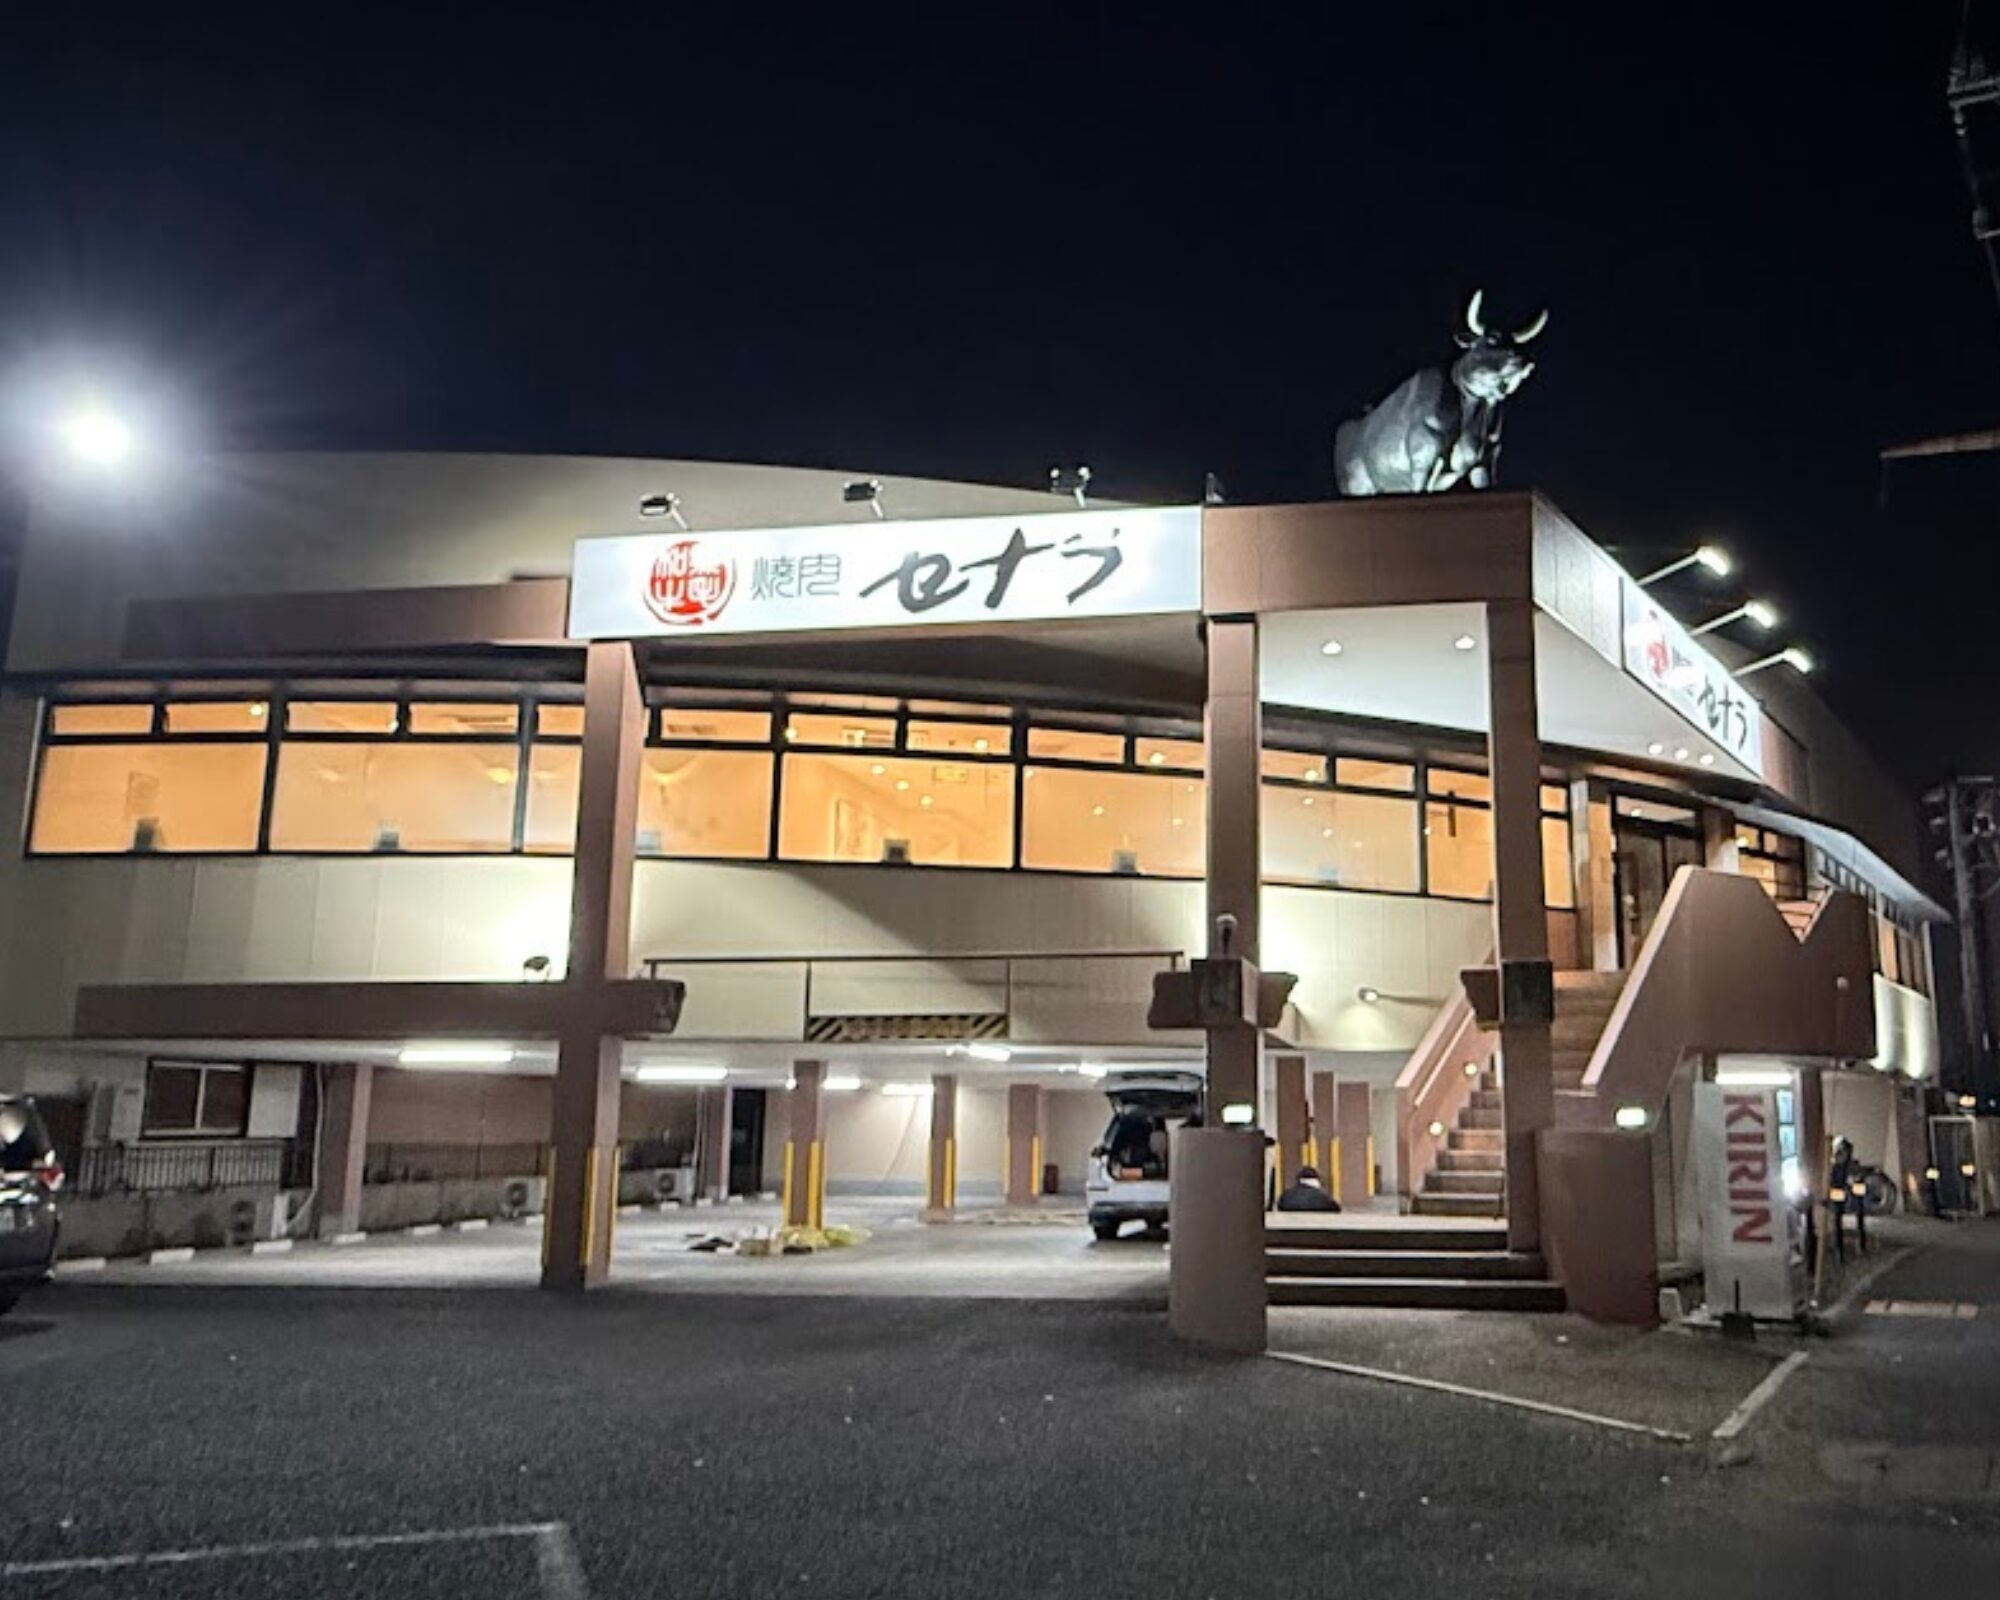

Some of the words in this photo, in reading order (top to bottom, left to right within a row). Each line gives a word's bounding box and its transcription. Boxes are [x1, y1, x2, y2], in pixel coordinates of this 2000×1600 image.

[859, 527, 1123, 613] セナラ
[1723, 1094, 1773, 1243] KIRIN
